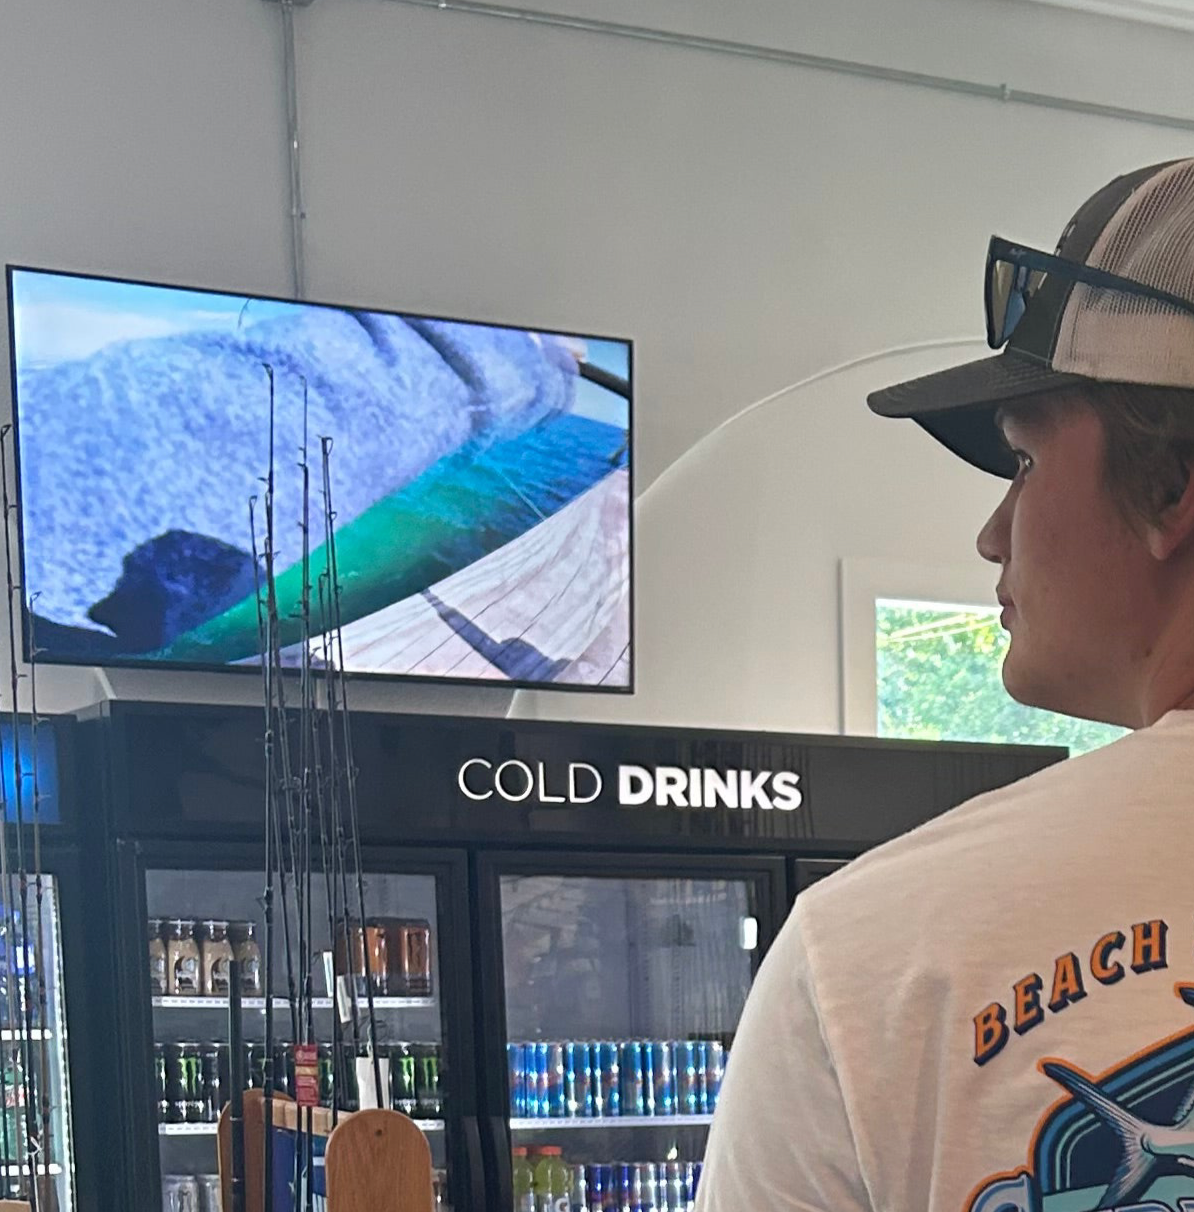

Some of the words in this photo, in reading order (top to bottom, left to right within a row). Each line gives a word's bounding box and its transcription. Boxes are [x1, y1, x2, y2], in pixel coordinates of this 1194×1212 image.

[458, 758, 602, 803] COLD
[618, 765, 802, 810] DRINKS
[973, 919, 1168, 1066] BEACH
